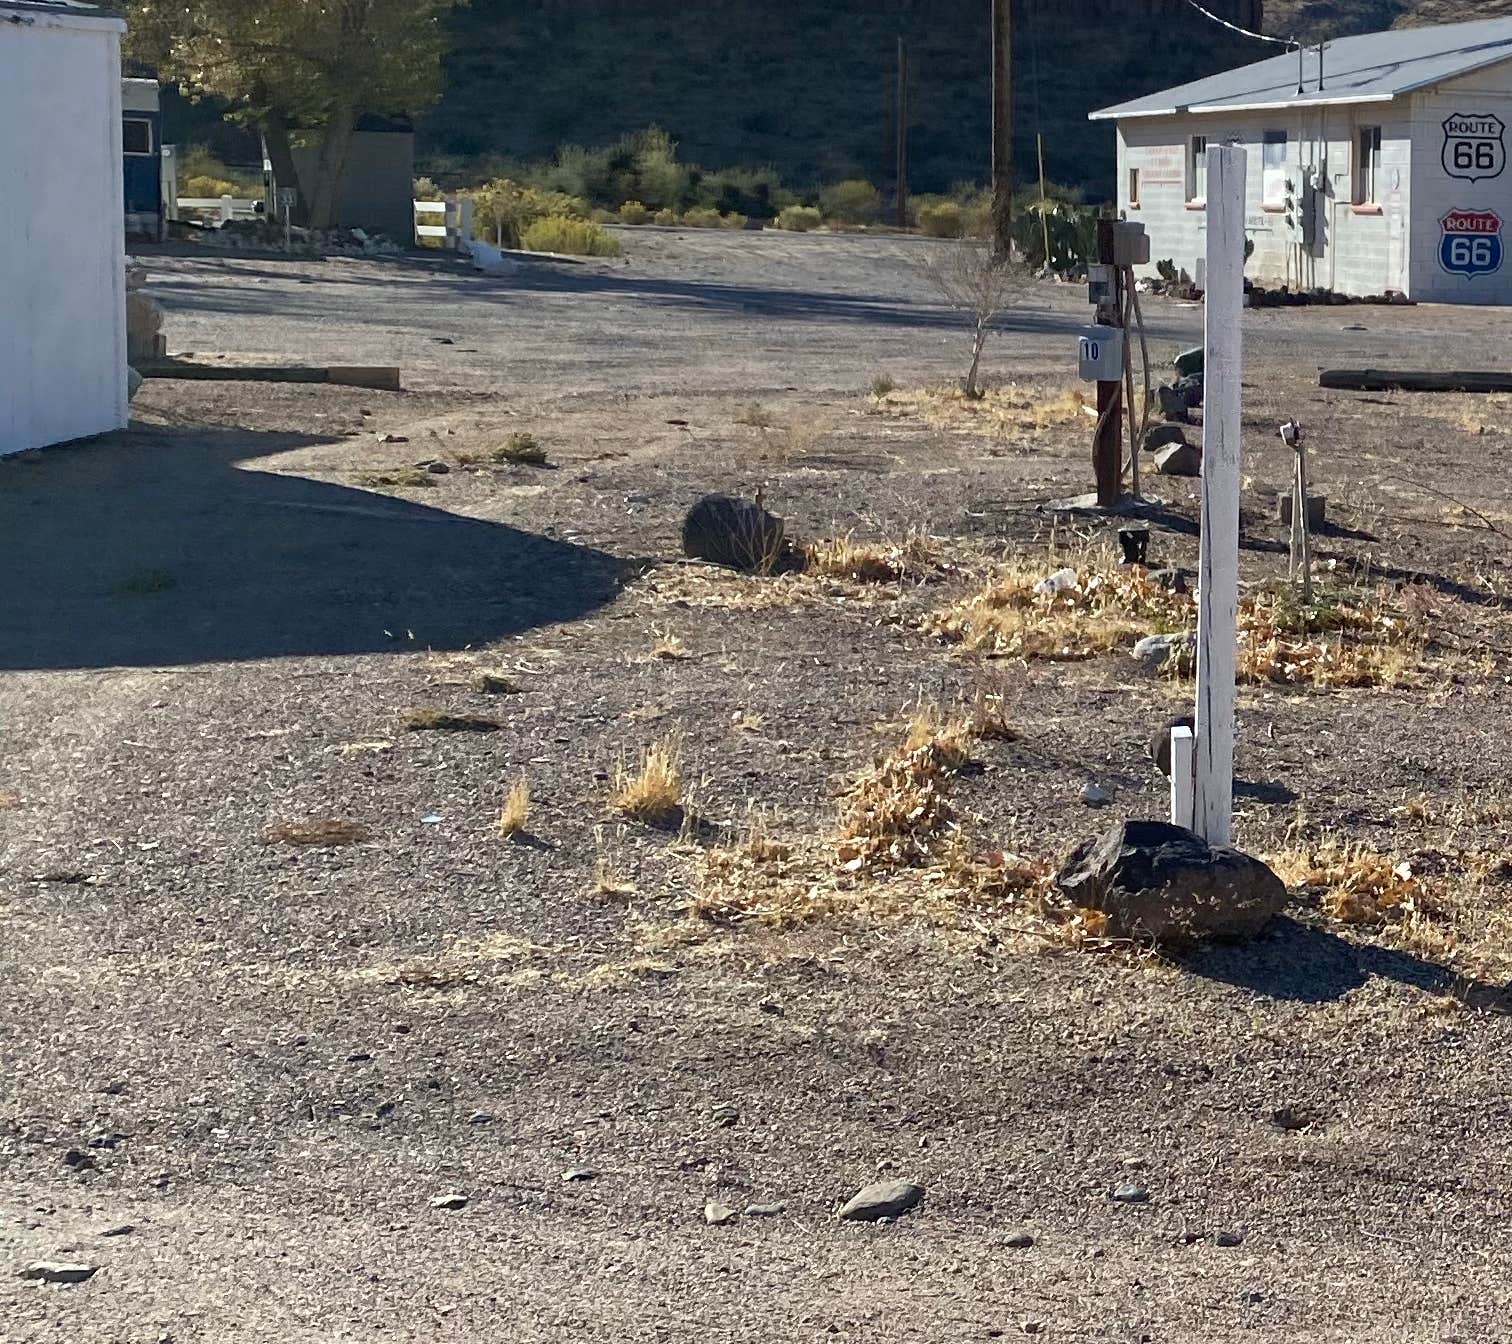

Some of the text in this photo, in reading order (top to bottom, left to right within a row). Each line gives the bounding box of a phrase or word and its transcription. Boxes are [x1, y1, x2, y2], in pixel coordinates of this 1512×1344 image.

[1449, 121, 1496, 134] ROUTE
[1454, 141, 1494, 169] 66
[1446, 217, 1494, 231] ROUTE
[1450, 237, 1491, 266] 66
[1084, 342, 1099, 361] 10
